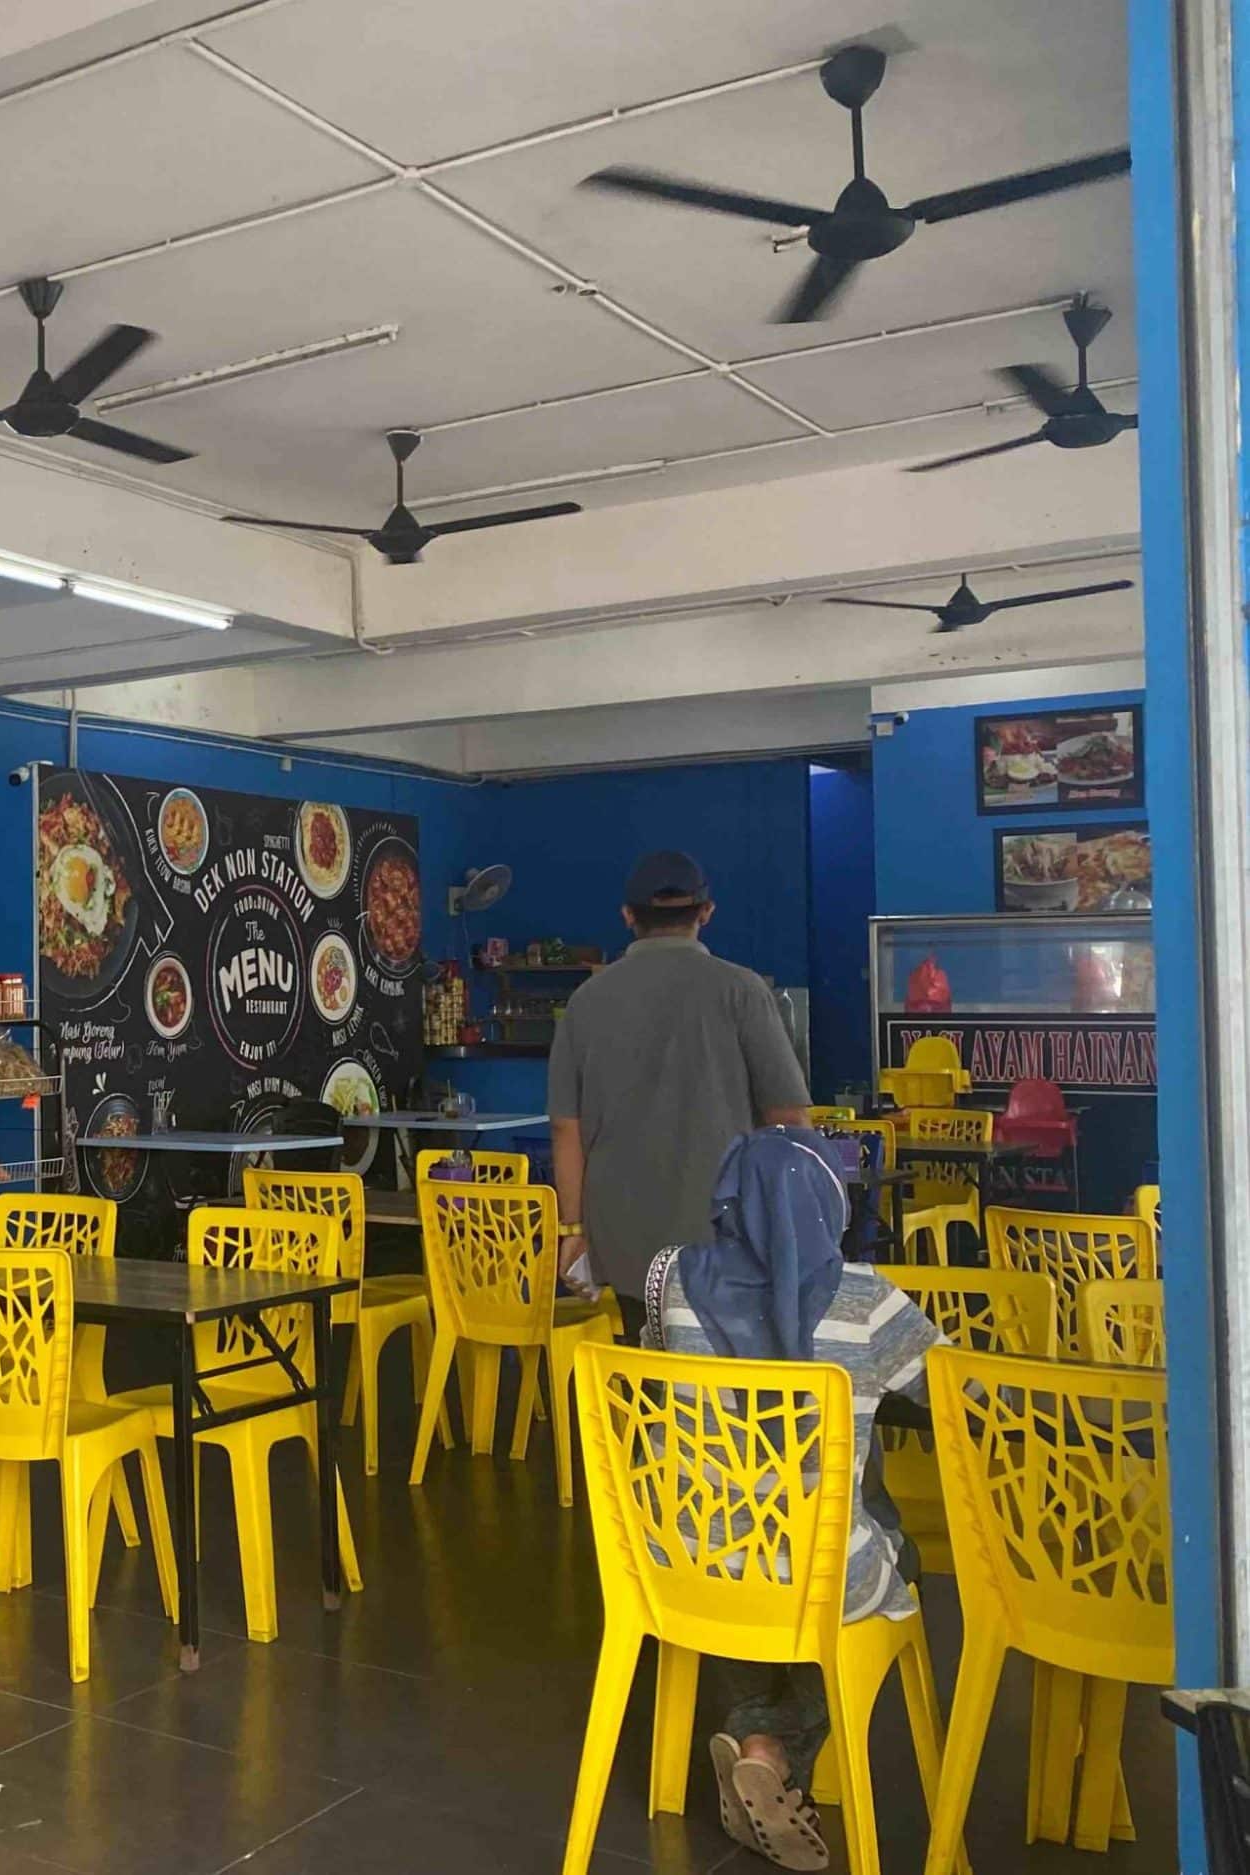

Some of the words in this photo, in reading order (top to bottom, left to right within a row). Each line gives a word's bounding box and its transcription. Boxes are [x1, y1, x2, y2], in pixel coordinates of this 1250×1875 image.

[193, 862, 226, 914] DEK
[225, 848, 256, 882] NON
[261, 850, 315, 923] STATION
[245, 920, 266, 941] The
[218, 947, 294, 1014] MENU
[245, 999, 288, 1015] RESTAURANT
[59, 1021, 81, 1040] Nasi
[81, 1020, 115, 1044] Goreng
[239, 1040, 264, 1061] ENJOY
[970, 1030, 1046, 1082] AYAM
